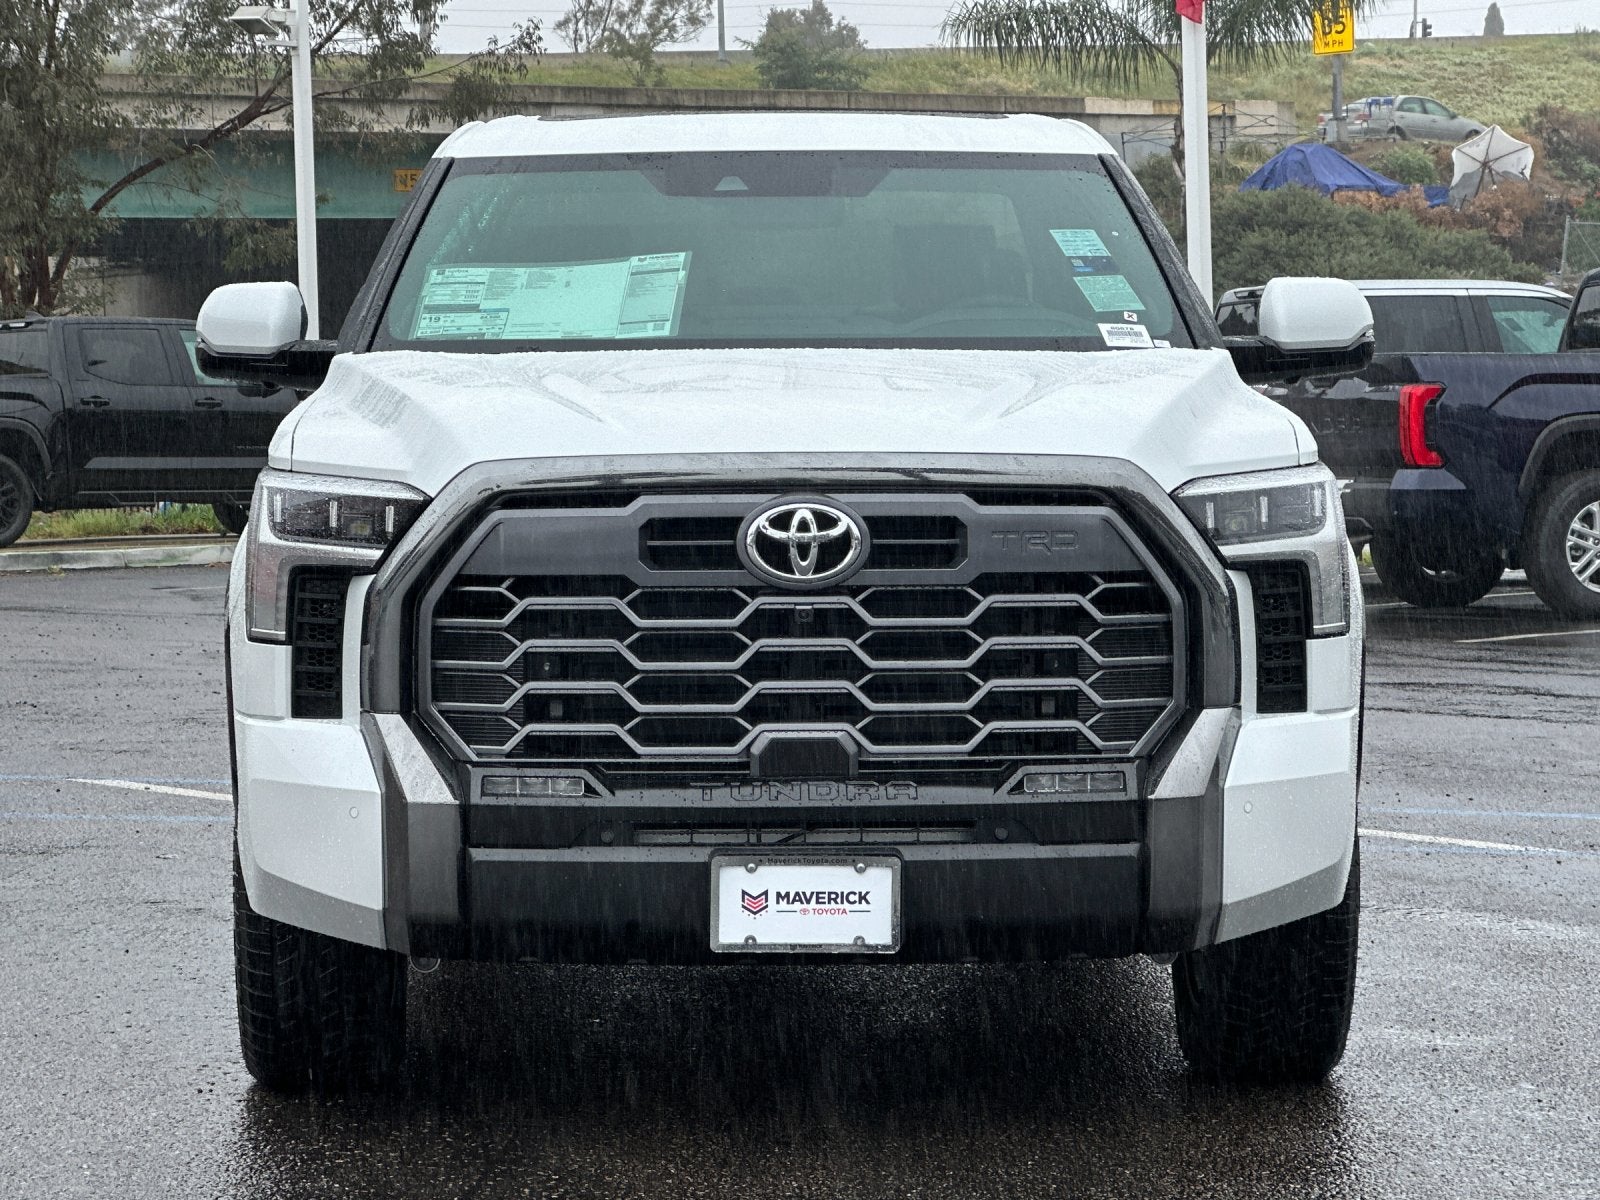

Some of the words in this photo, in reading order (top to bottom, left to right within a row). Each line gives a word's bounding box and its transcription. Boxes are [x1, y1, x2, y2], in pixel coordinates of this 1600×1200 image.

[1324, 39, 1344, 48] MPH
[991, 530, 1080, 555] TRD
[689, 780, 918, 802] TUNDRA
[767, 857, 848, 865] MaverickToyota.com
[775, 890, 871, 905] MAVERICK
[812, 908, 848, 916] TOYOTA
